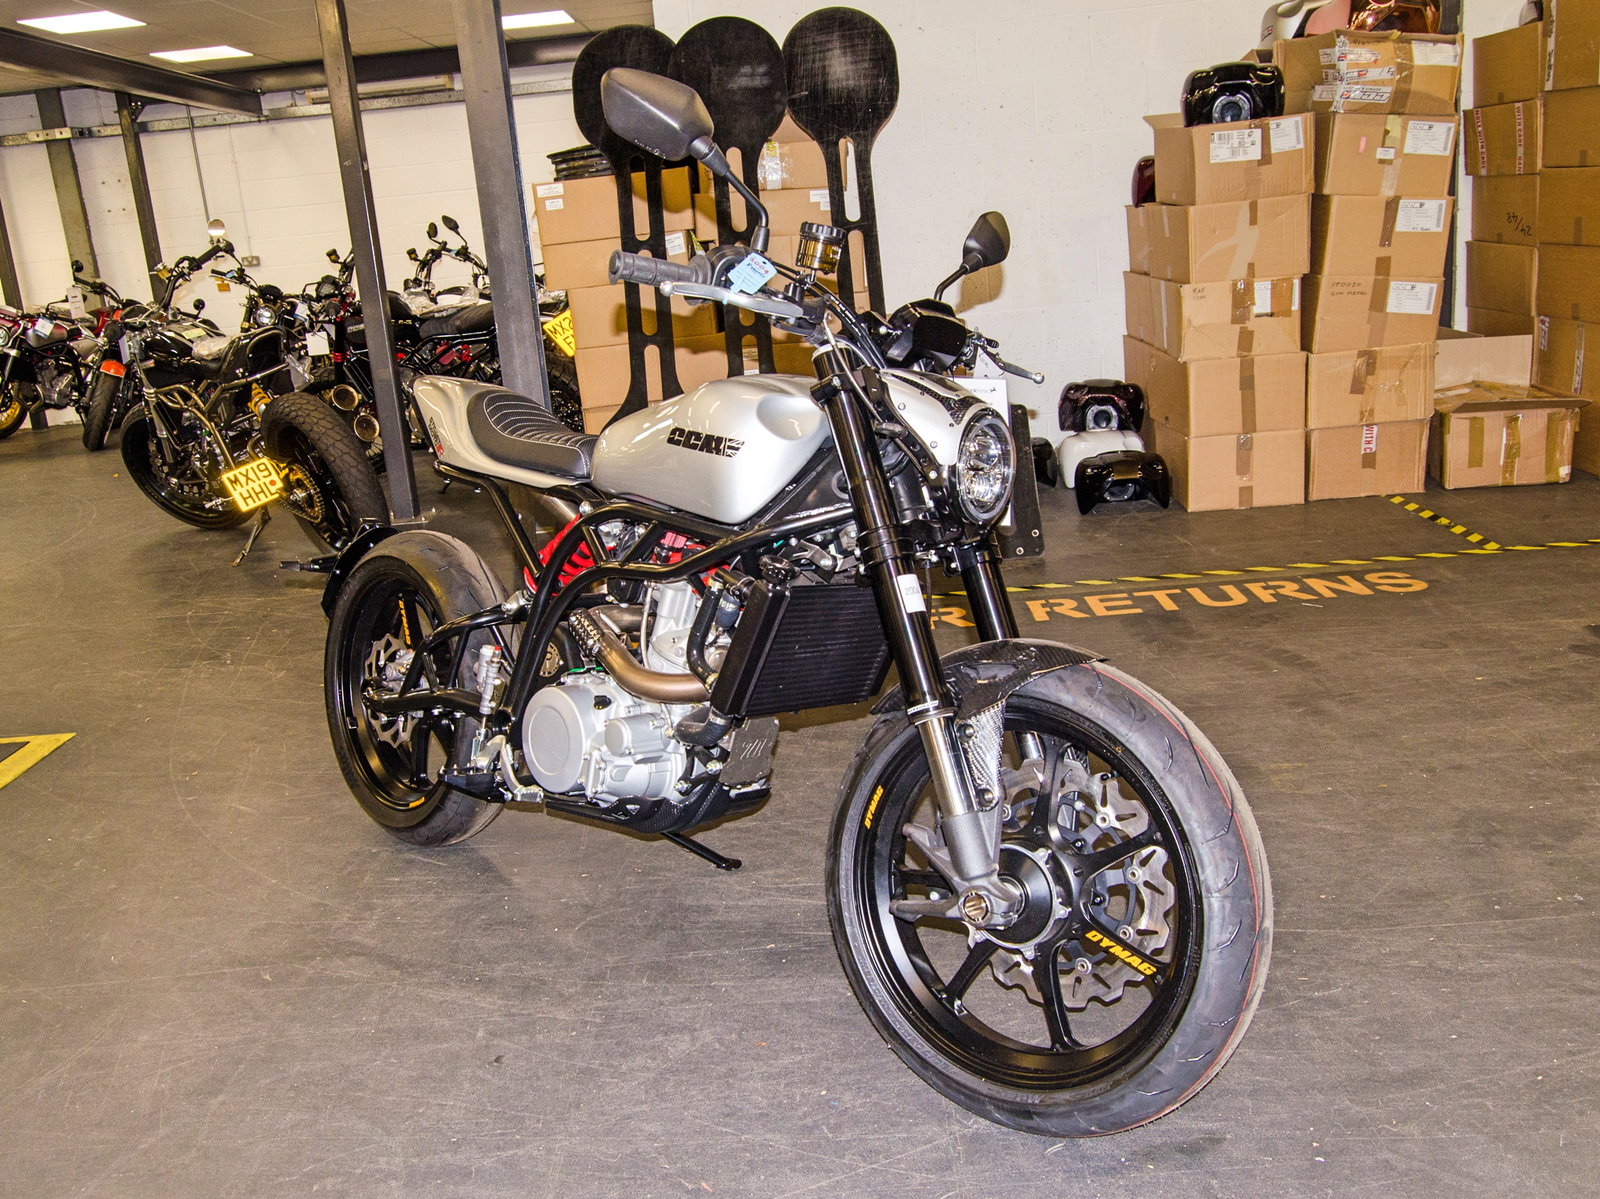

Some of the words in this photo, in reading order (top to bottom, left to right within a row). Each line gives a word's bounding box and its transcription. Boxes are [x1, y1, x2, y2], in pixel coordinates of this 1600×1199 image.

[667, 426, 724, 456] CCM
[227, 462, 272, 491] MX19
[1025, 572, 1429, 621] RETURNS
[1084, 930, 1157, 976] DYMAG
